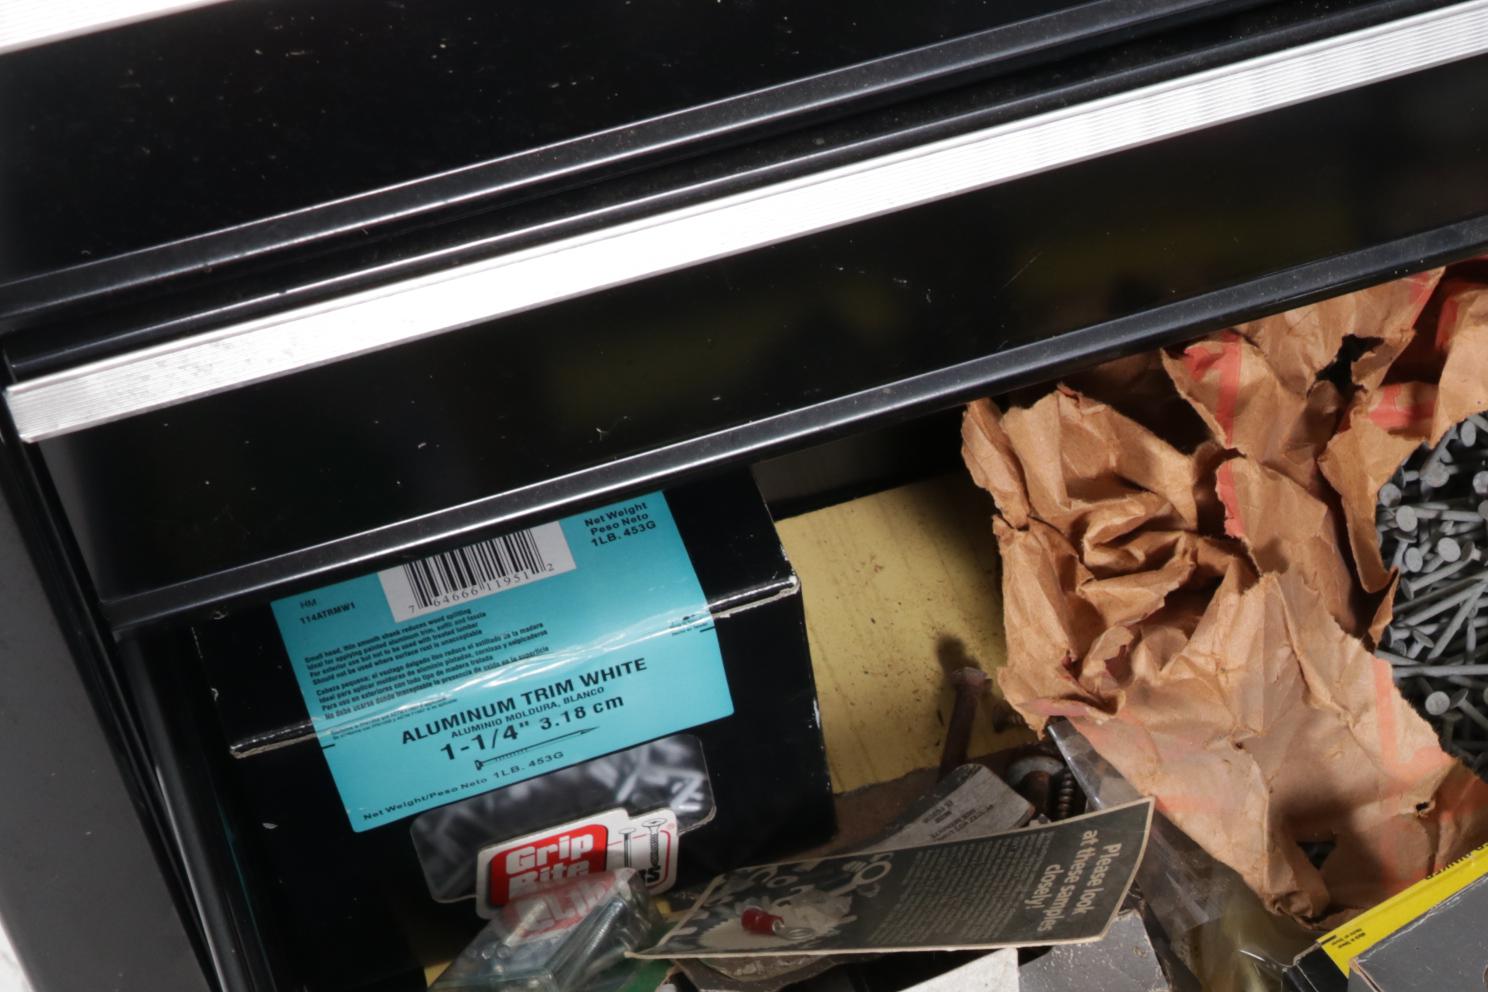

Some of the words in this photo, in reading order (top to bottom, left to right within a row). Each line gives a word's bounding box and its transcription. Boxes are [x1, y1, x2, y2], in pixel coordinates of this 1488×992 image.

[584, 515, 605, 527] Net
[605, 501, 648, 521] Weight
[590, 520, 619, 535] Peso
[621, 512, 648, 526] Neto
[591, 531, 621, 546] 1LB.
[622, 519, 656, 536] 453G
[399, 696, 516, 744] ALUMINUM
[520, 678, 576, 706] TRIM
[579, 657, 647, 688] WHITE
[450, 716, 502, 739] ALUMINIO
[505, 699, 561, 723] MOLDURA,
[562, 685, 605, 704] BLANCO
[439, 720, 533, 762] 1-1/4"
[538, 705, 587, 731] 3.18
[592, 695, 624, 714] cm
[361, 808, 385, 822] Net
[387, 784, 459, 816] Weight/Peso
[464, 776, 488, 789] Neto
[493, 763, 525, 779] 1LB.
[527, 750, 564, 767] 453G
[502, 830, 596, 875] Grip
[1079, 827, 1099, 849] at
[1063, 845, 1095, 885] these
[1086, 839, 1121, 889] Please
[1036, 882, 1074, 933] samples
[1071, 883, 1103, 918] look
